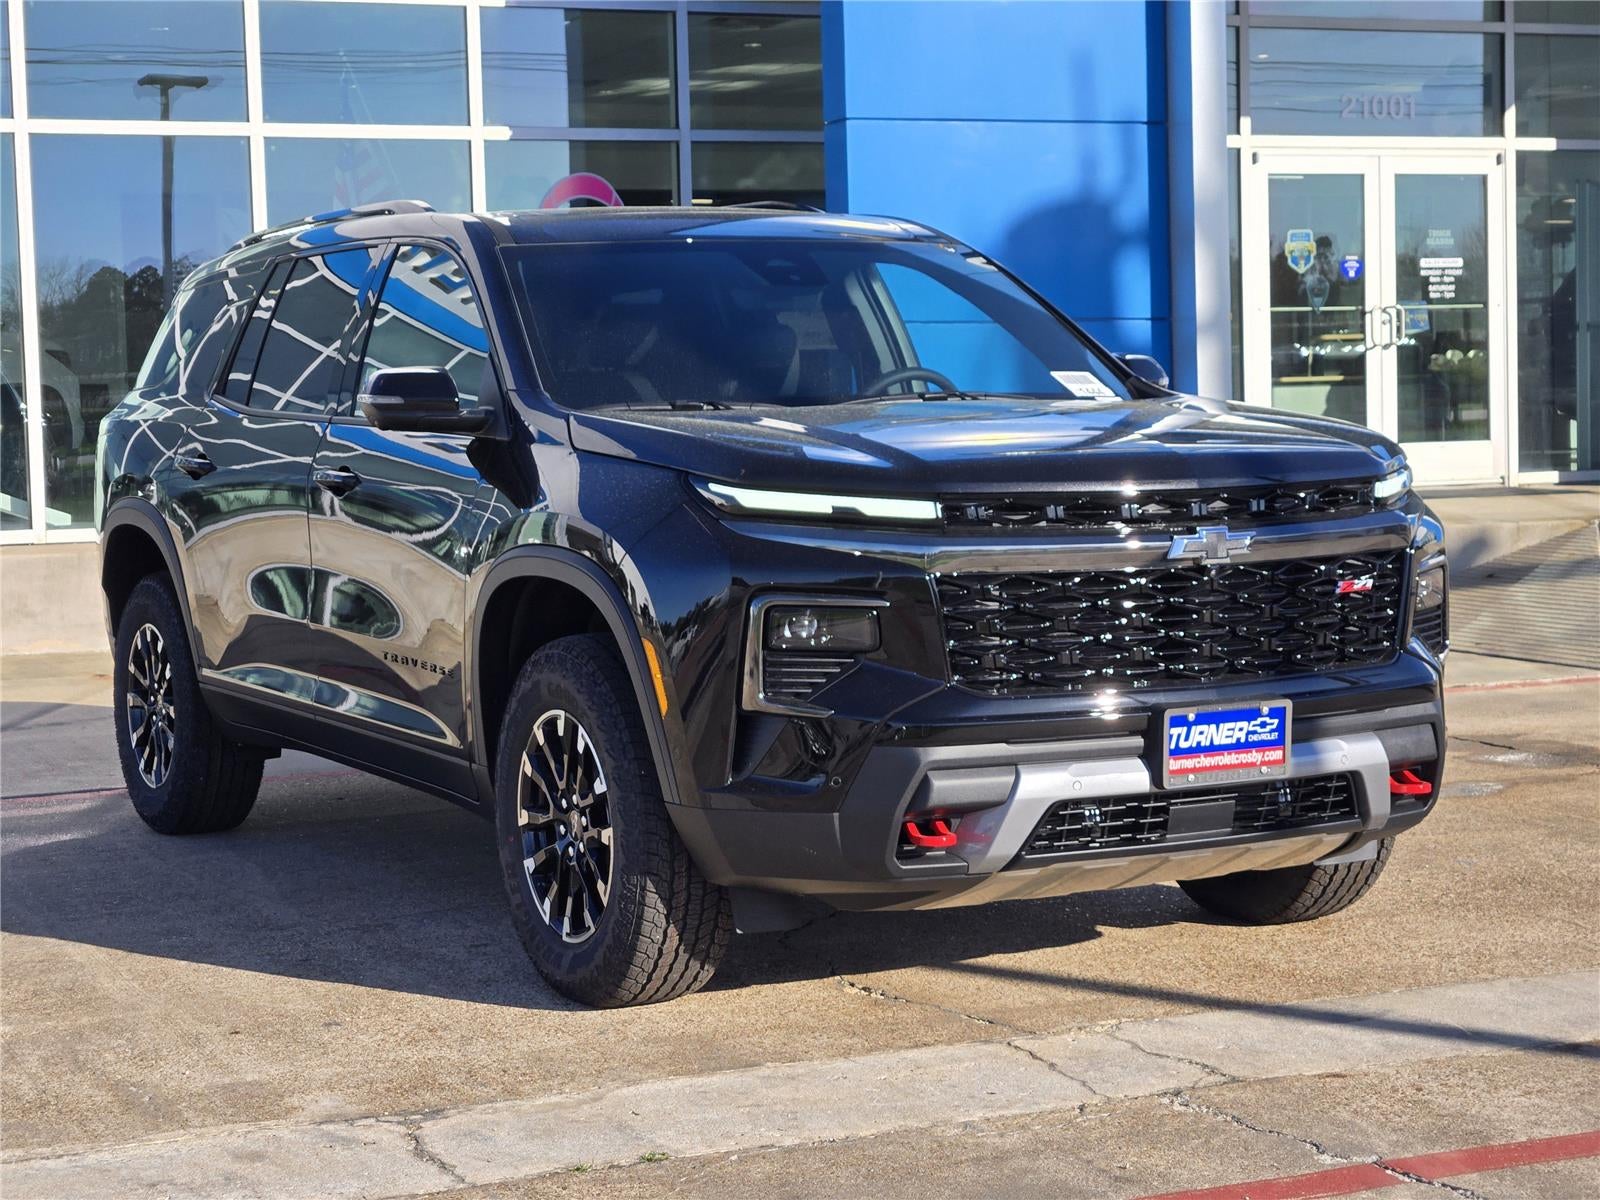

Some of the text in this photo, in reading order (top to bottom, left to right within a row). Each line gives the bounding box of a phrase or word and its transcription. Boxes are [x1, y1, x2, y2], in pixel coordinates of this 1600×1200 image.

[1340, 94, 1416, 119] 21001
[383, 651, 454, 678] TRAVERSE
[1169, 721, 1249, 750] TURNER
[1248, 732, 1279, 742] CHEVROLET
[1169, 749, 1283, 770] turnerchevroletcrosby.com
